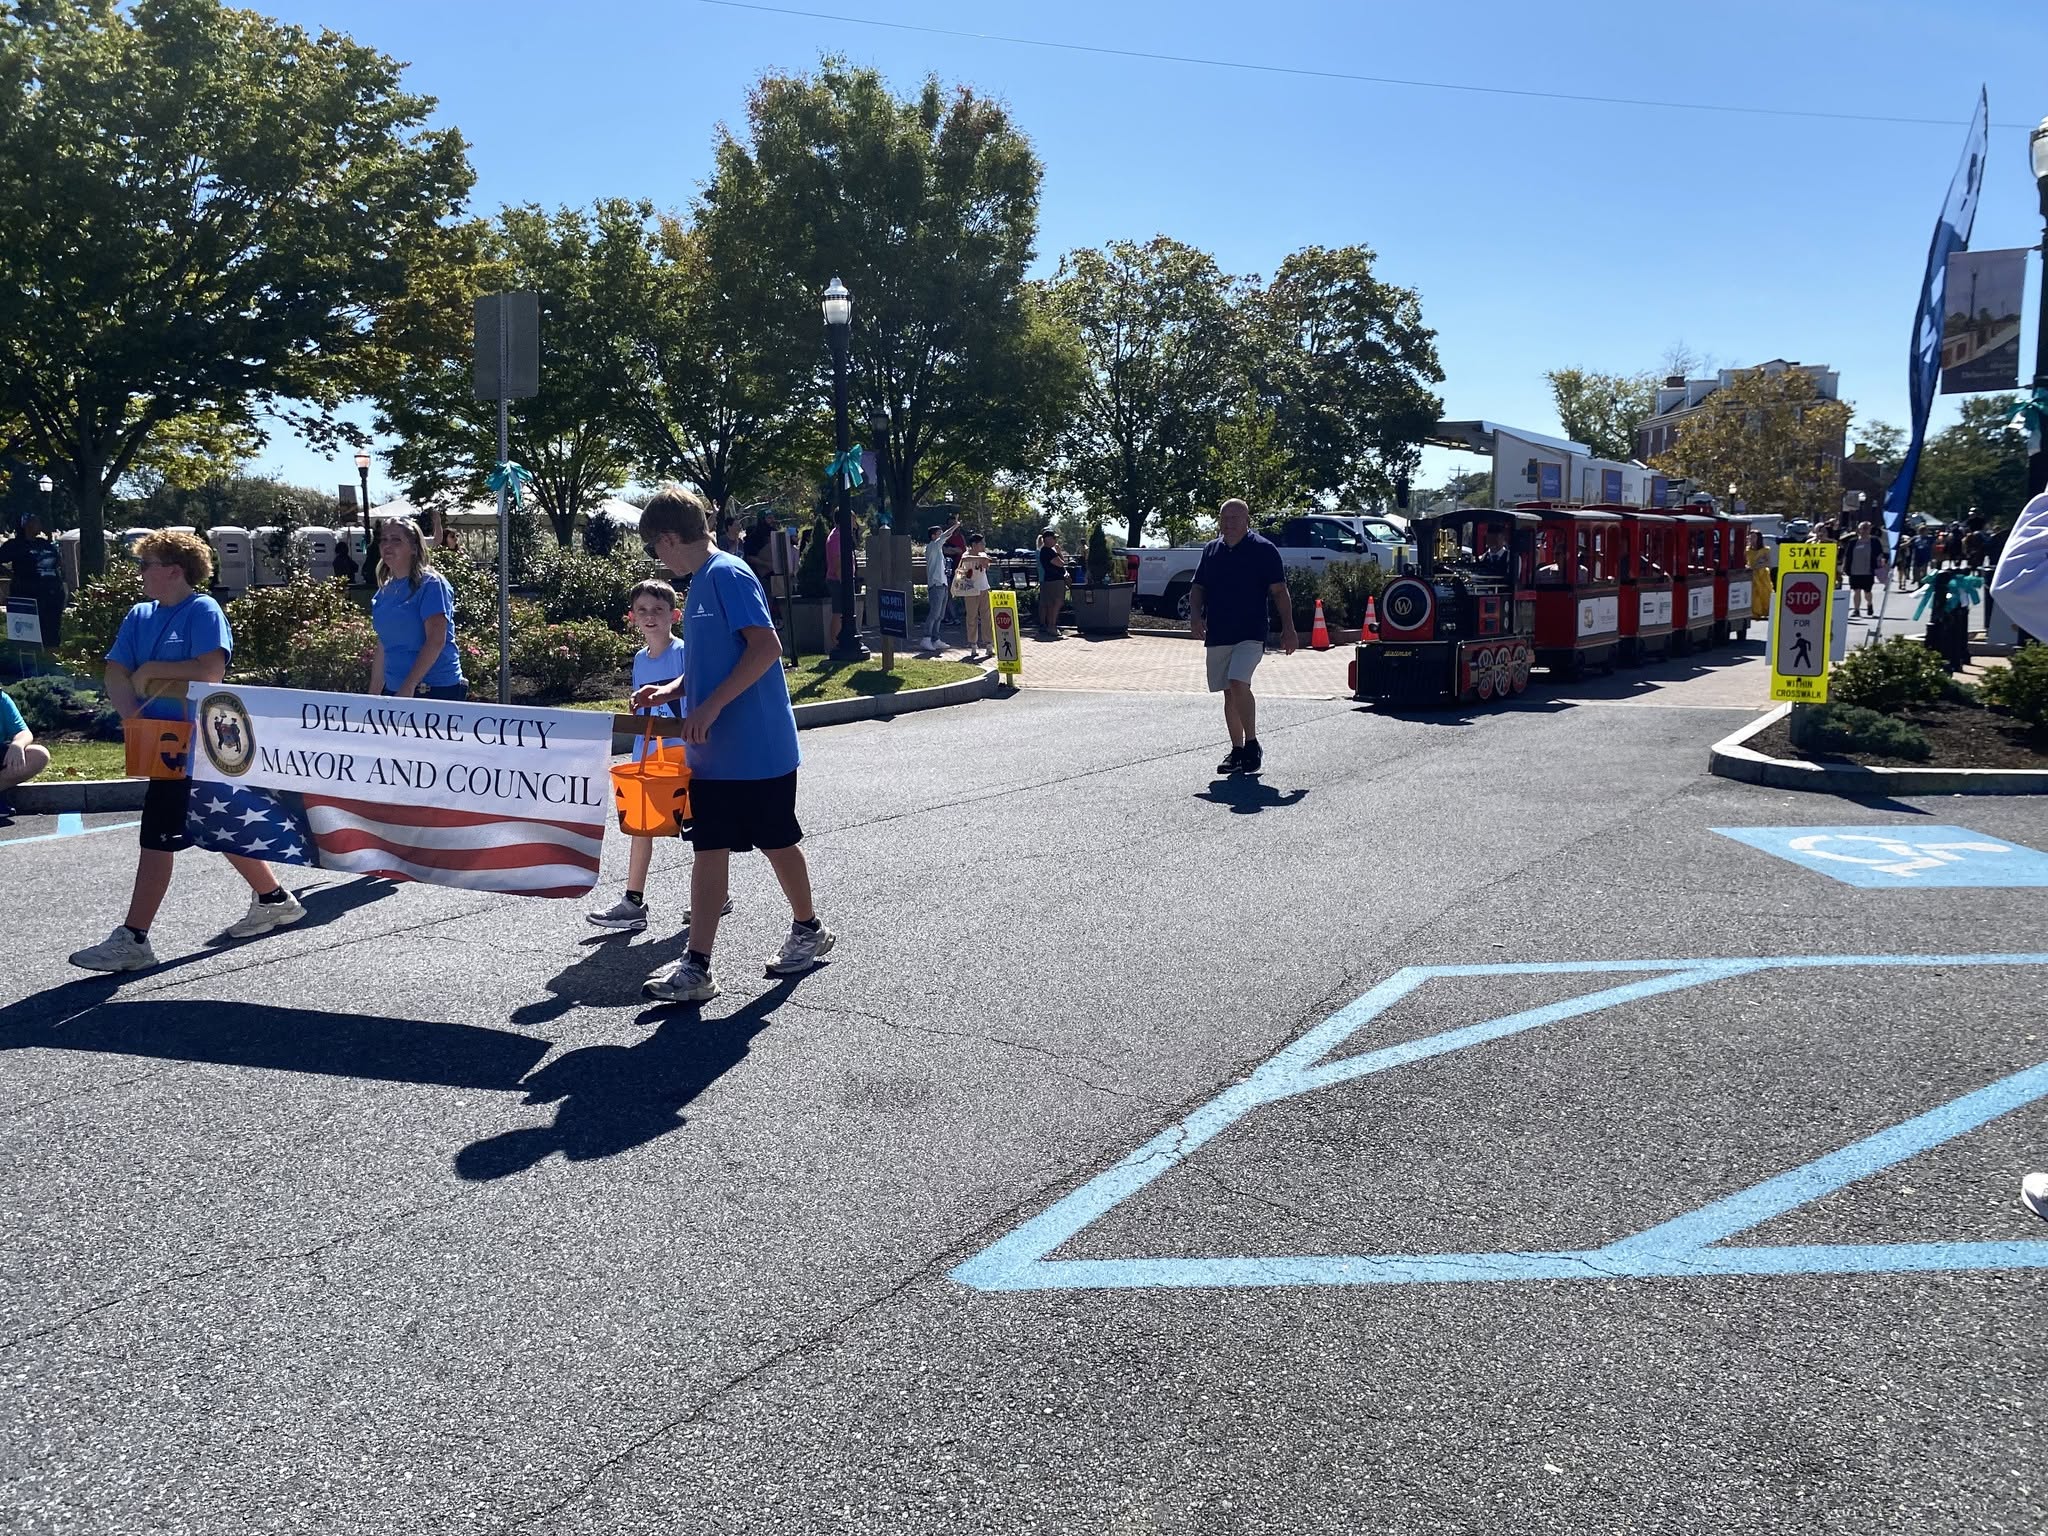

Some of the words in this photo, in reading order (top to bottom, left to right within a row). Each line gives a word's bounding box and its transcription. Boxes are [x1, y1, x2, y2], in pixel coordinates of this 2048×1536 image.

[1789, 547, 1826, 557] STATE
[1793, 559, 1820, 570] LAW
[1787, 591, 1819, 605] STOP
[1397, 601, 1411, 613] W
[880, 609, 905, 621] ALLOWED
[1793, 619, 1810, 627] FOR
[1786, 680, 1813, 688] WITHIN
[1776, 689, 1821, 698] CROSSWALK
[300, 703, 464, 742] DELAWARE
[473, 717, 557, 749] CITY
[260, 746, 355, 782] MAYOR
[366, 758, 437, 790] AND
[446, 764, 602, 807] COUNCIL
